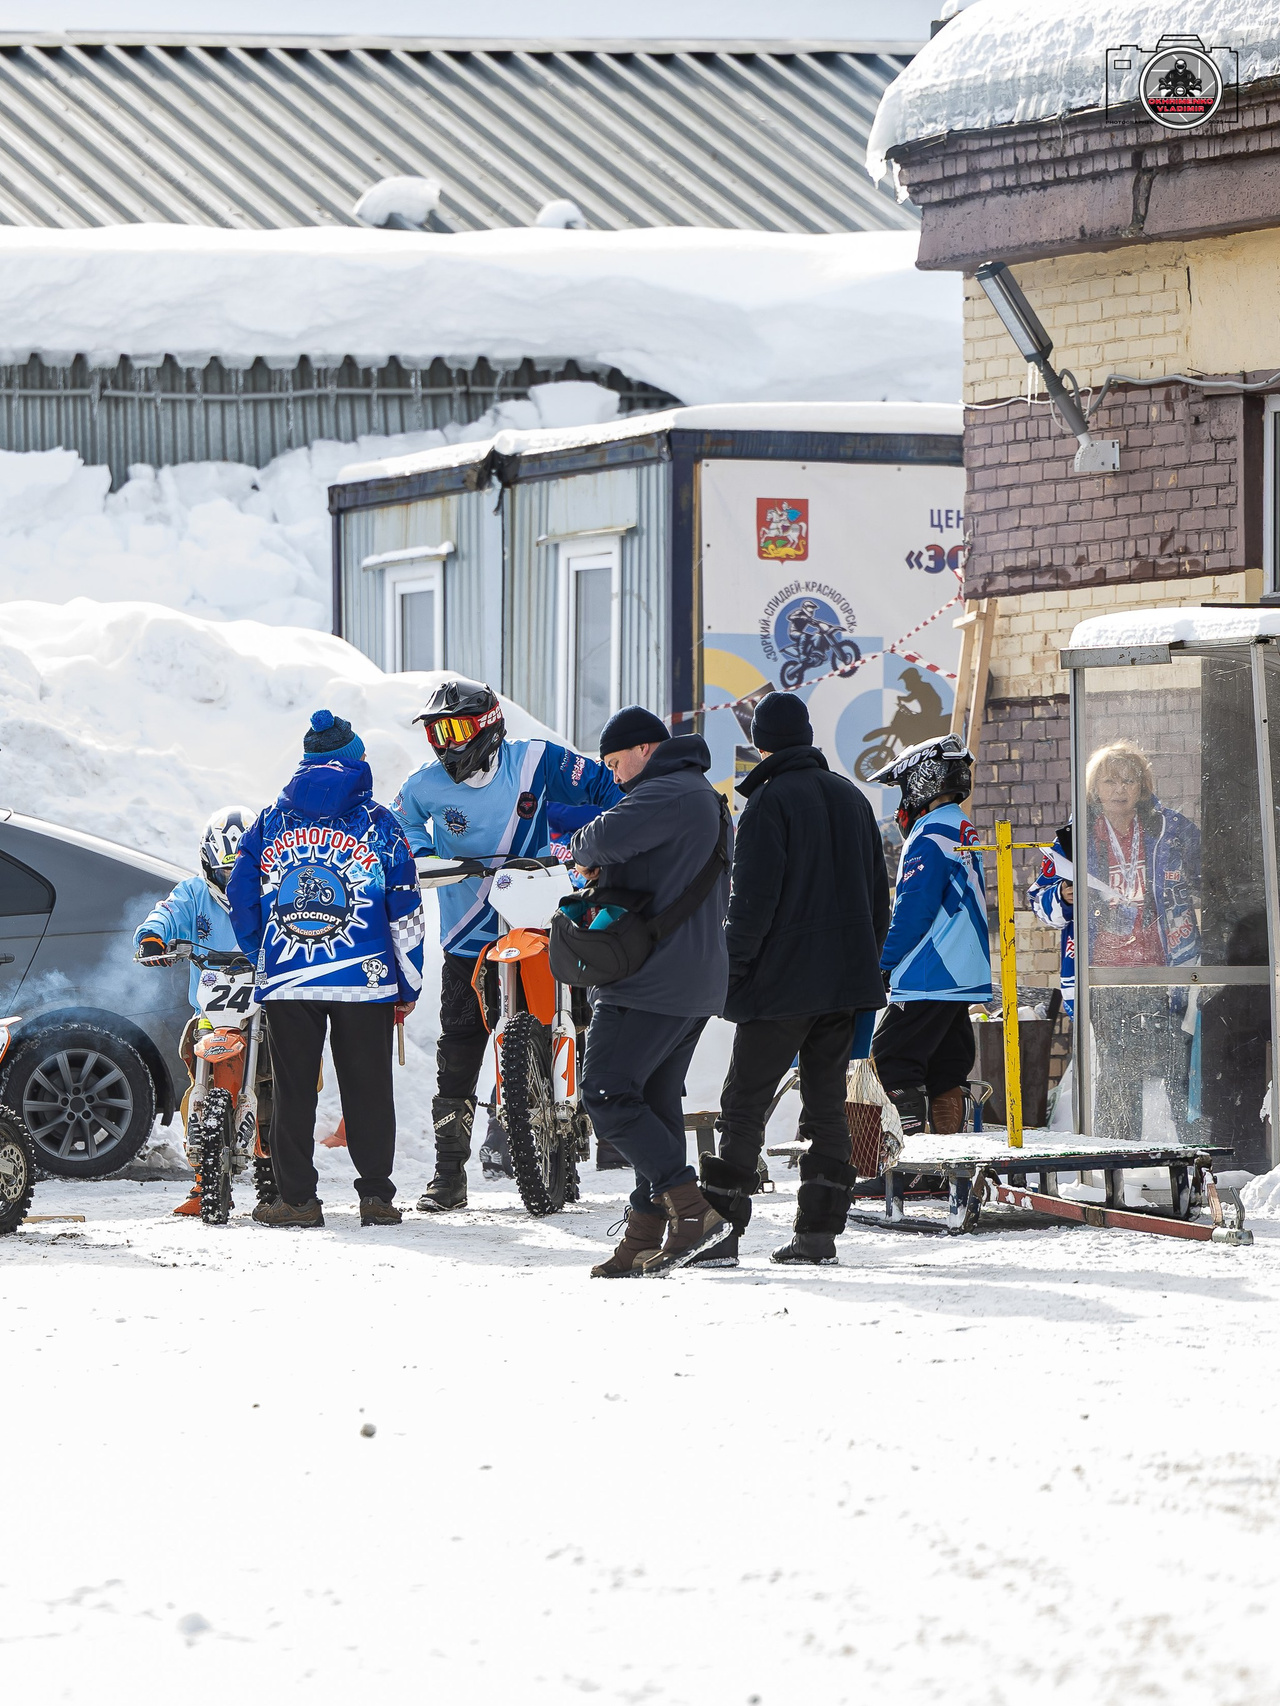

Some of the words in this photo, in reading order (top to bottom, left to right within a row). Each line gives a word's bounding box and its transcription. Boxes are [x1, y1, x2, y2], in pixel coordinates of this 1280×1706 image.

[891, 746, 938, 779] 100%
[260, 827, 380, 874] КРАСНОГОРСК
[282, 911, 343, 926] МОТОСПОРТ
[287, 923, 334, 937] КРАСНОГОРСК
[205, 985, 254, 1013] 24
